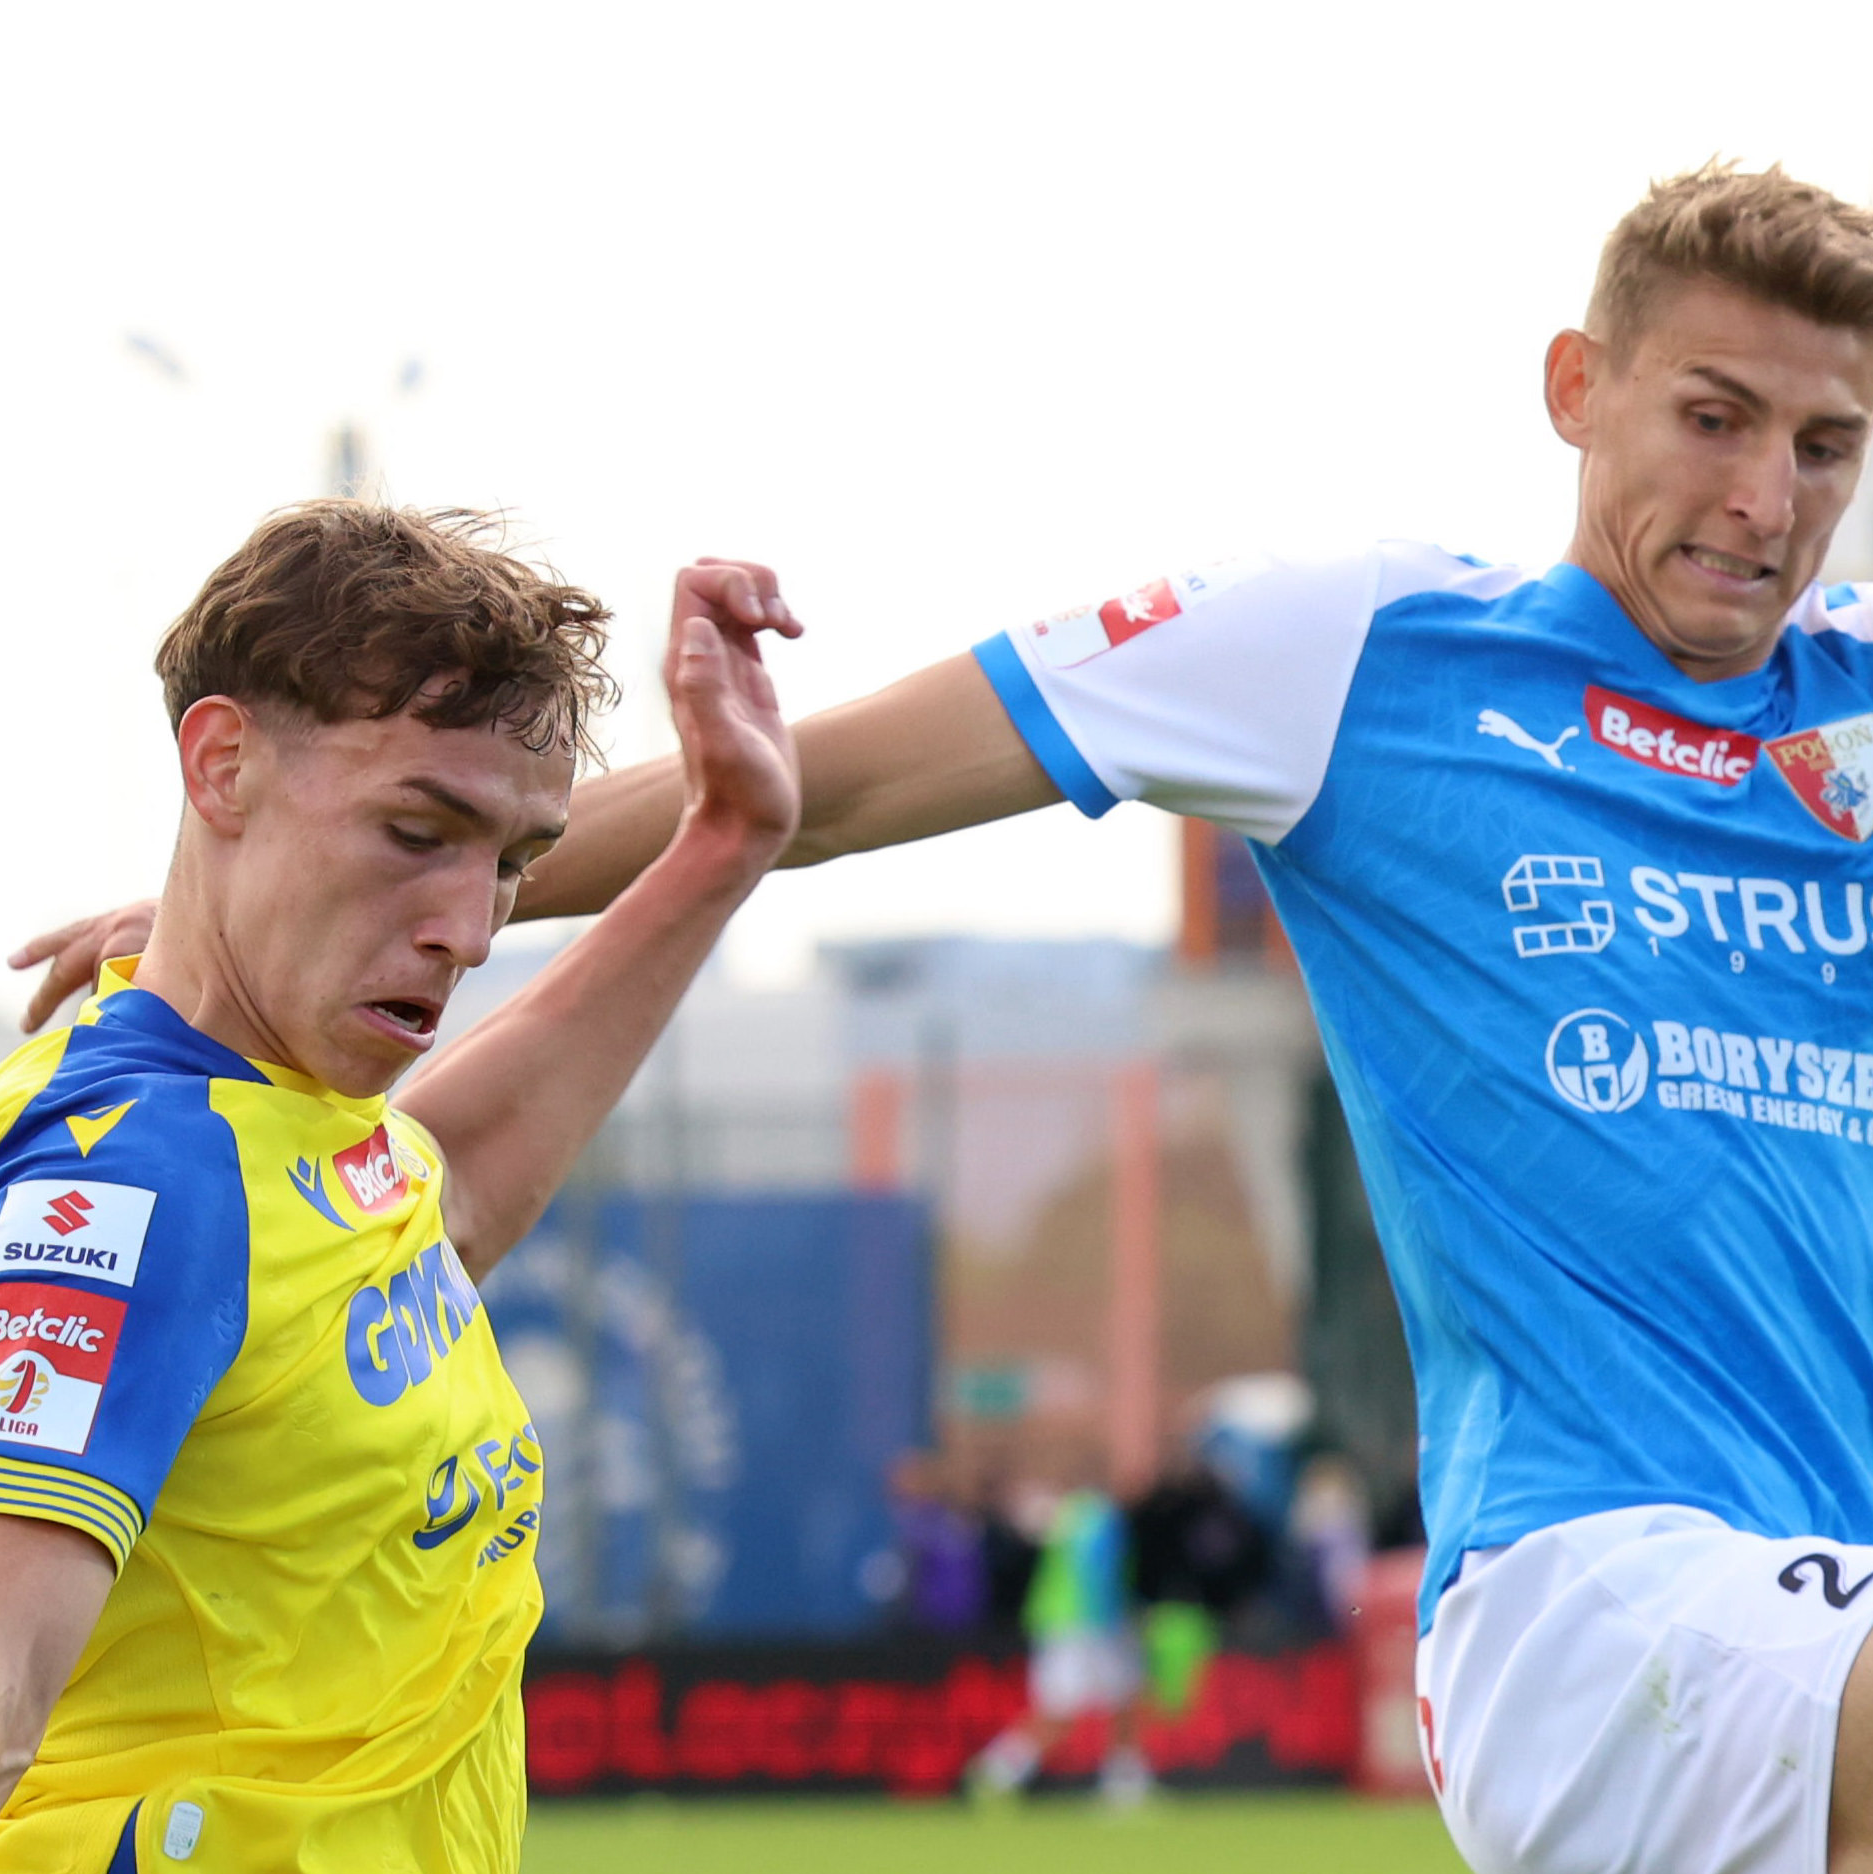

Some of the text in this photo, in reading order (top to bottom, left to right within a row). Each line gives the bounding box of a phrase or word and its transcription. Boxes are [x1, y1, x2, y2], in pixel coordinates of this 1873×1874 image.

[1600, 704, 1752, 781] Betclic
[1657, 1080, 1746, 1119] GREEN
[1752, 1093, 1844, 1137] ENERGY
[1846, 1118, 1864, 1144] &
[3, 1241, 118, 1271] SUZUKI
